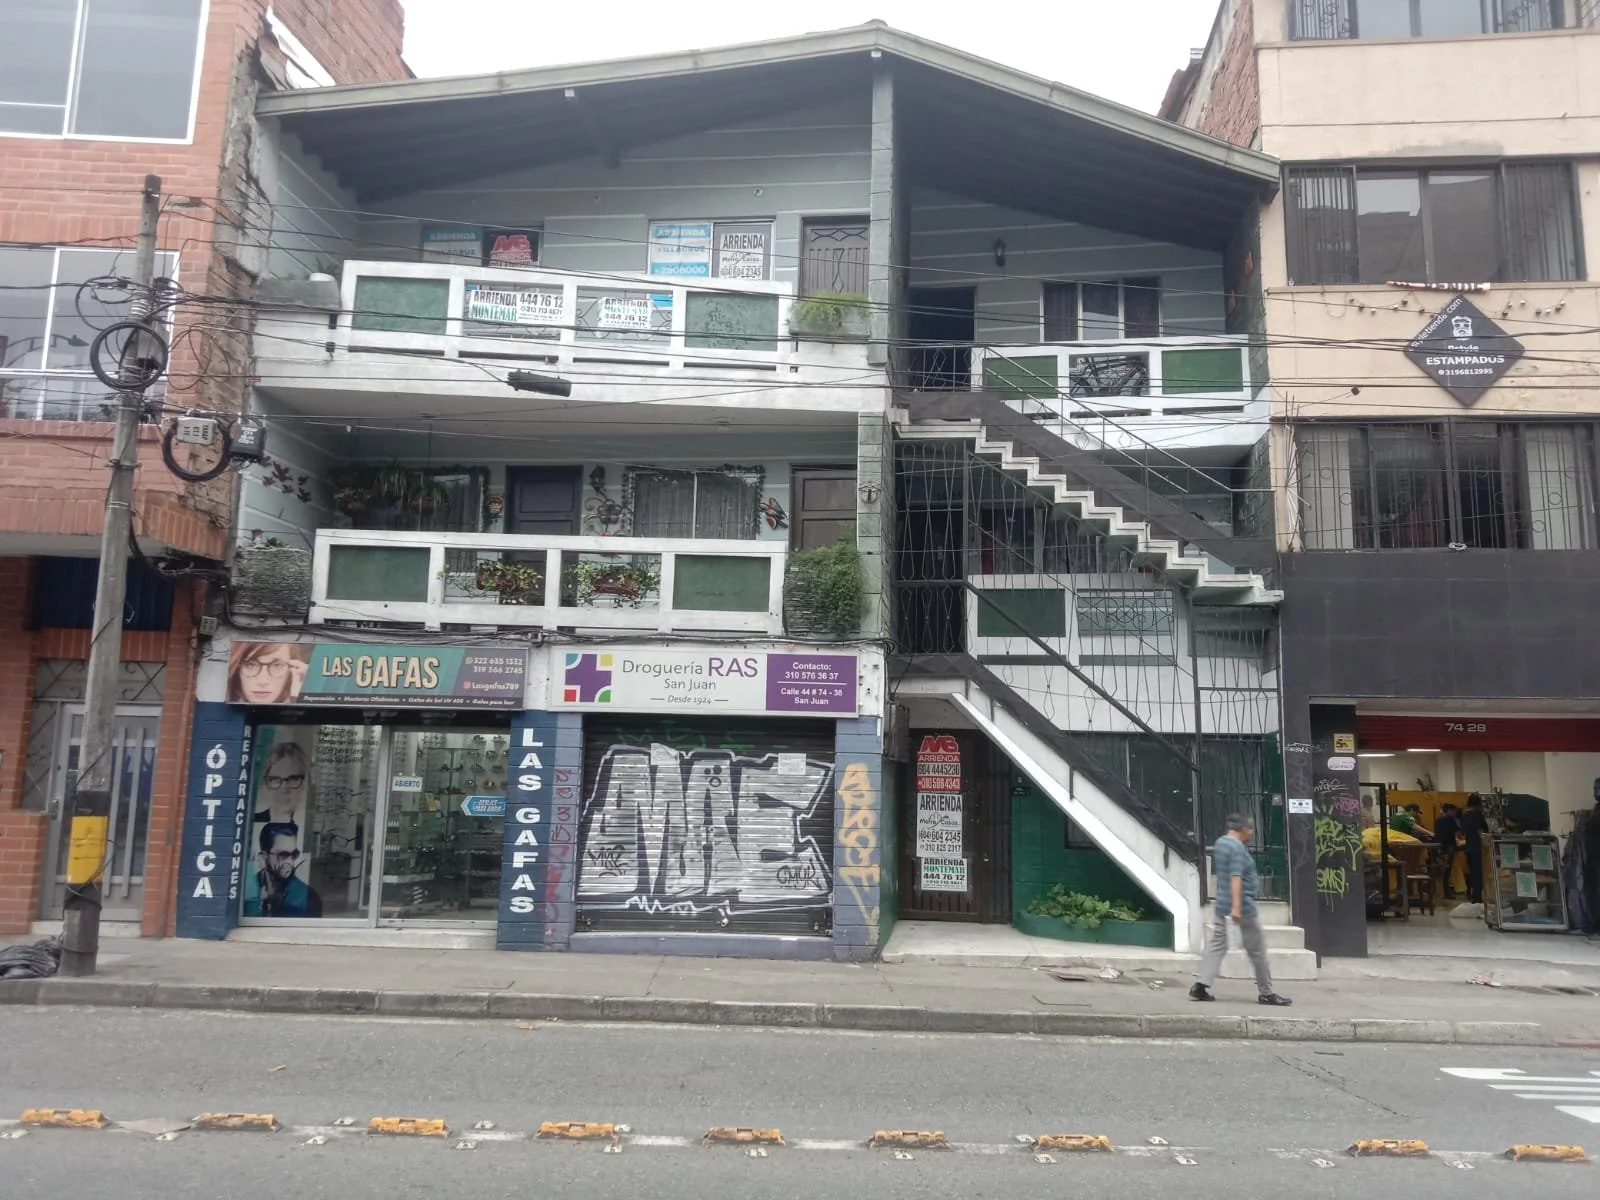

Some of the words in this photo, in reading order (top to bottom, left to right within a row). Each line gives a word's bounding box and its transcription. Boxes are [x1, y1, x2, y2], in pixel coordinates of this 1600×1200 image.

[722, 234, 764, 249] ARRIENDA
[474, 291, 517, 306] ARRIENDA
[520, 293, 538, 306] 444
[540, 294, 552, 307] 76
[554, 296, 564, 308] 12
[605, 298, 649, 309] ARRIENDA
[472, 304, 517, 321] MONTEMAR
[1426, 355, 1505, 365] ESTAMPADOS
[321, 656, 353, 677] LAS
[355, 655, 440, 689] GAFAS
[622, 659, 703, 678] Droguería
[708, 657, 758, 678] RAS
[792, 662, 832, 671] Contacto:
[785, 671, 800, 679] 310
[801, 672, 816, 680] 576
[664, 678, 686, 689] San
[688, 679, 716, 692] Juan
[780, 687, 800, 696] Calle
[801, 688, 811, 696] 44
[819, 688, 828, 696] 74
[667, 695, 691, 703] Desde
[693, 697, 712, 705] 1924
[794, 697, 809, 705] San
[811, 697, 829, 705] Juan
[1444, 722, 1465, 732] 74
[519, 728, 543, 791] LAS
[394, 780, 421, 789] ABIERTO
[920, 794, 962, 812] ARRIENDA
[229, 724, 252, 900] REPARACIONES
[192, 744, 227, 898] ÓPTICA
[932, 831, 944, 841] 604
[945, 831, 961, 842] 2345
[509, 807, 541, 913] GAFAS
[924, 858, 965, 866] ARRIENDA
[923, 865, 966, 874] MONTEMAR
